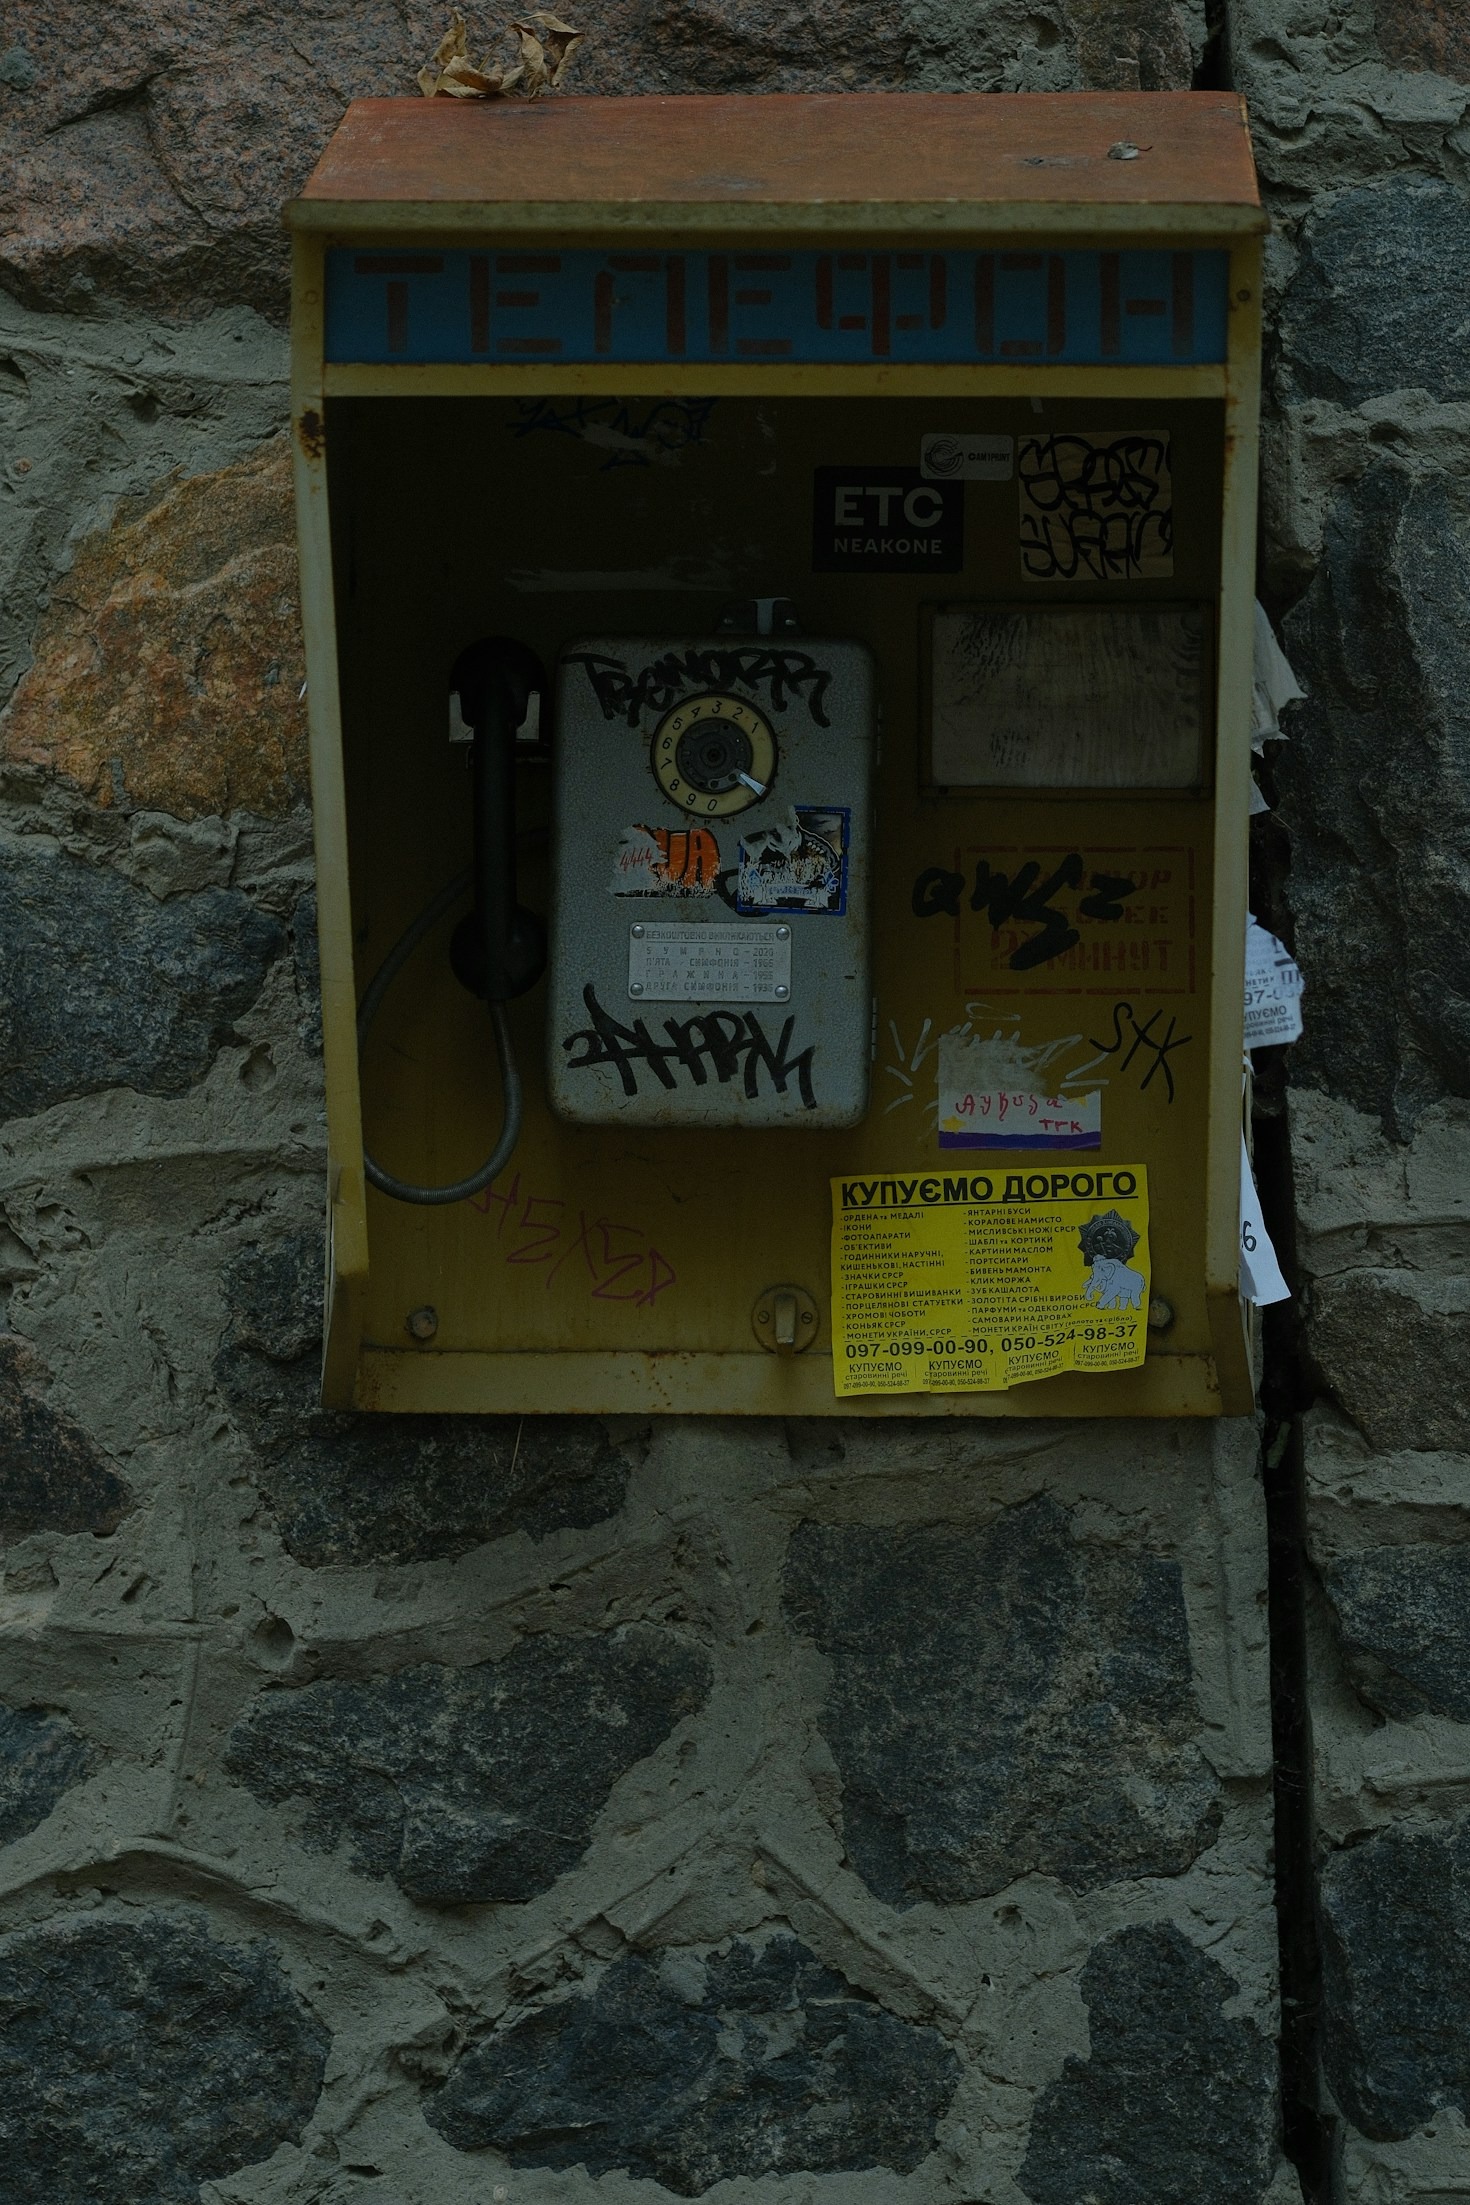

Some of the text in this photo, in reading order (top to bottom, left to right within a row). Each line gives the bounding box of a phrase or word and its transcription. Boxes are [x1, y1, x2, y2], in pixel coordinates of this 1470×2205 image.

[354, 252, 1193, 357] ТЕЛЕФОН
[834, 486, 944, 527] ETC
[834, 538, 943, 554] NEAKONE
[661, 700, 759, 811] 1 2 3 4 5 6 7 8 9 0
[690, 958, 739, 967] СИМФОНІЯ
[645, 982, 676, 991] ДРУГА
[684, 982, 739, 991] СИМФОНІЯ
[842, 1172, 1137, 1206] КУПУЄМО ДОРОГО
[891, 1212, 924, 1220] МЕДАЛІ
[1018, 1216, 1062, 1224] НАМИСТО
[1029, 1226, 1053, 1234] НОЖІ
[1011, 1236, 1053, 1244] КОРТИКИ
[1014, 1246, 1053, 1254] МАСЛОМ
[903, 1260, 945, 1268] НАСТІННІ
[1006, 1266, 1052, 1274] МАМОНТА
[887, 1281, 908, 1289] СРСР
[904, 1289, 961, 1298] ВИШИВАНКИ
[989, 1286, 1040, 1294] КАШАЛОТА
[913, 1298, 963, 1307] СТАТУЕТКИ
[1050, 1294, 1086, 1302] ВИРОБИ
[1028, 1304, 1078, 1312] ОДЕКОЛОН
[889, 1309, 926, 1318] ЧОБОТИ
[1038, 1313, 1072, 1321] ДРОВАХ
[885, 1320, 905, 1328] СРСР
[1011, 1323, 1038, 1332] КРАЇН
[1041, 1322, 1063, 1331] СВІТУ
[930, 1328, 952, 1336] СРСР
[846, 1324, 1138, 1358] 097-099-00-90, 050-524-98-37
[1083, 1342, 1135, 1353] КУПУЄМО
[1008, 1350, 1059, 1365] КУПУЄМО
[850, 1361, 902, 1373] КУПУЄМО
[929, 1359, 983, 1370] КУПУЄМО
